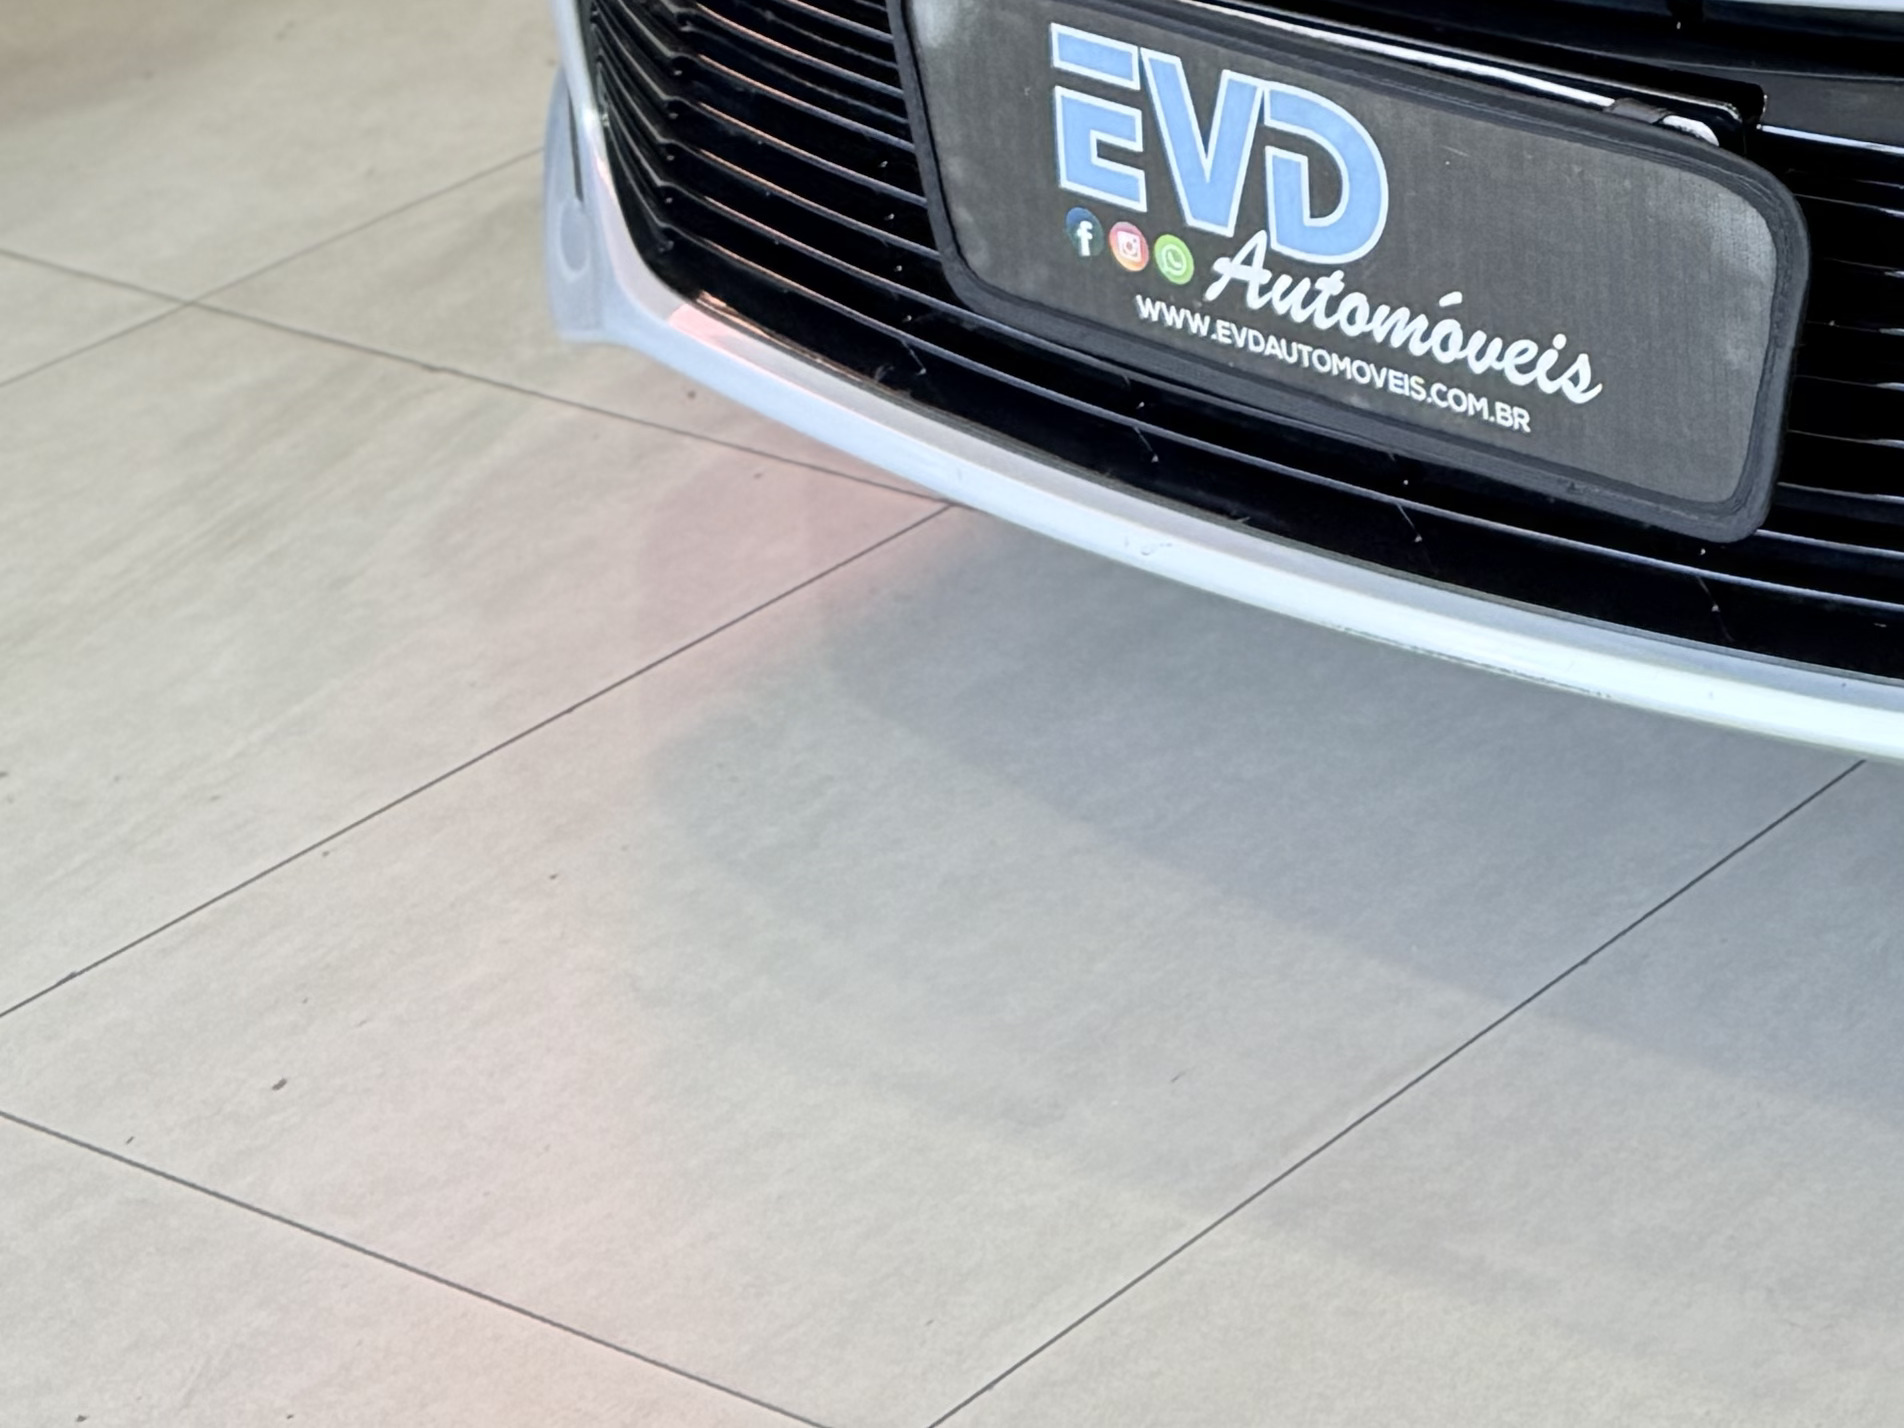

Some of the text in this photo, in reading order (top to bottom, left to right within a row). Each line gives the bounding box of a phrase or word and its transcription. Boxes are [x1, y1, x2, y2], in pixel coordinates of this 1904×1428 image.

[1050, 23, 1389, 264] EVD
[1136, 293, 1533, 434] WWW.EVDAUTOMOVEIS.COM.BR
[1205, 230, 1603, 405] Automóveis
